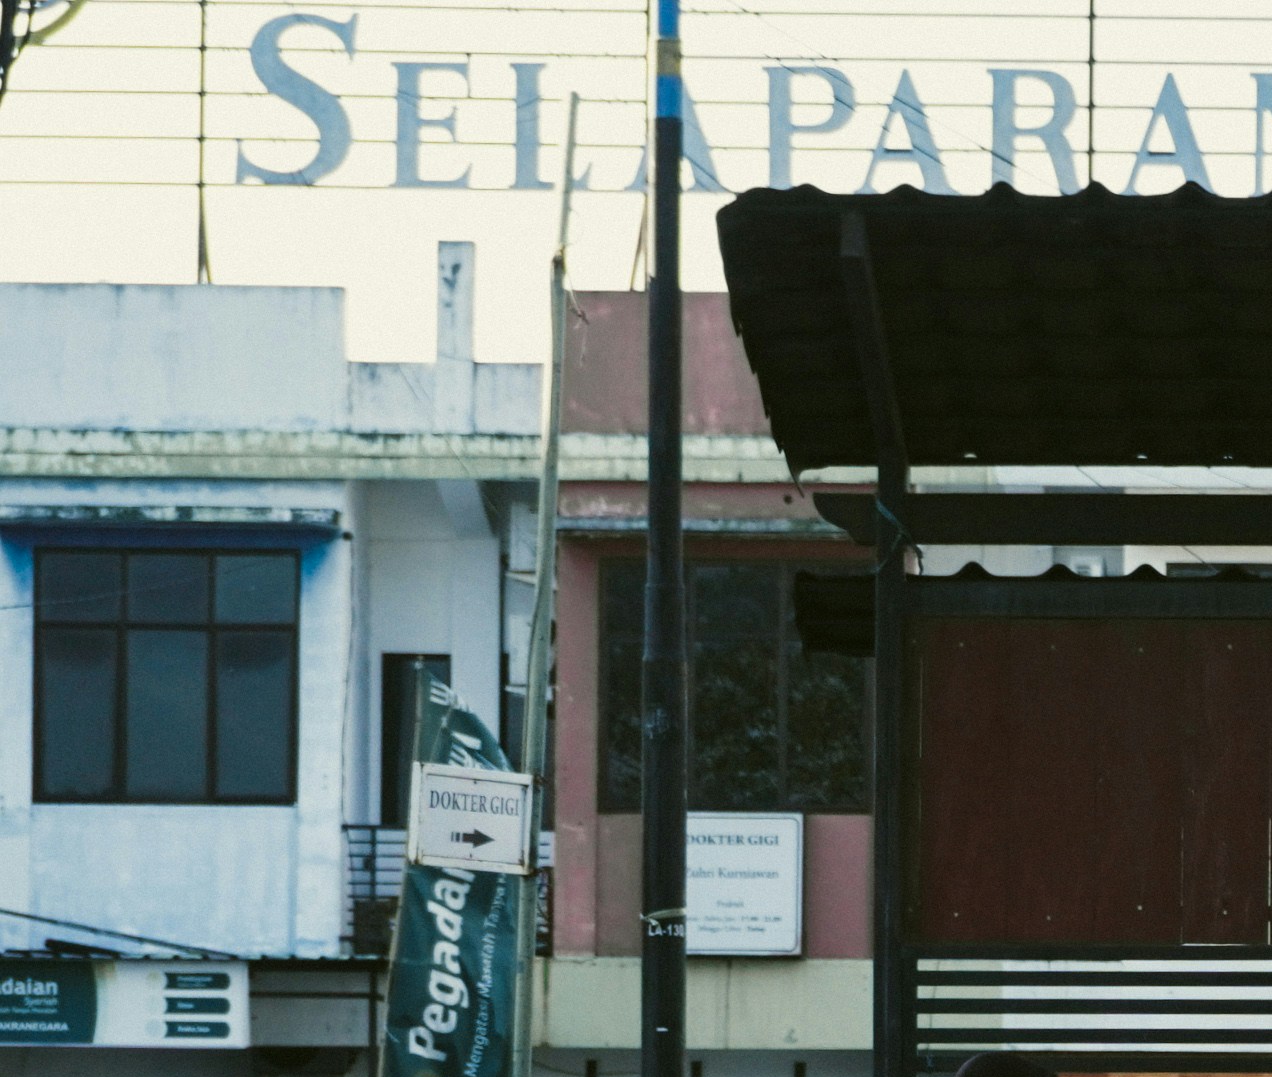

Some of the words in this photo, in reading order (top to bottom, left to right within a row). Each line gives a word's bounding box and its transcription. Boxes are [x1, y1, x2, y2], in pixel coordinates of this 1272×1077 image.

[430, 790, 487, 813] DOKTER
[491, 796, 519, 816] GIGI
[748, 835, 779, 846] GIGI
[0, 978, 58, 995] daian
